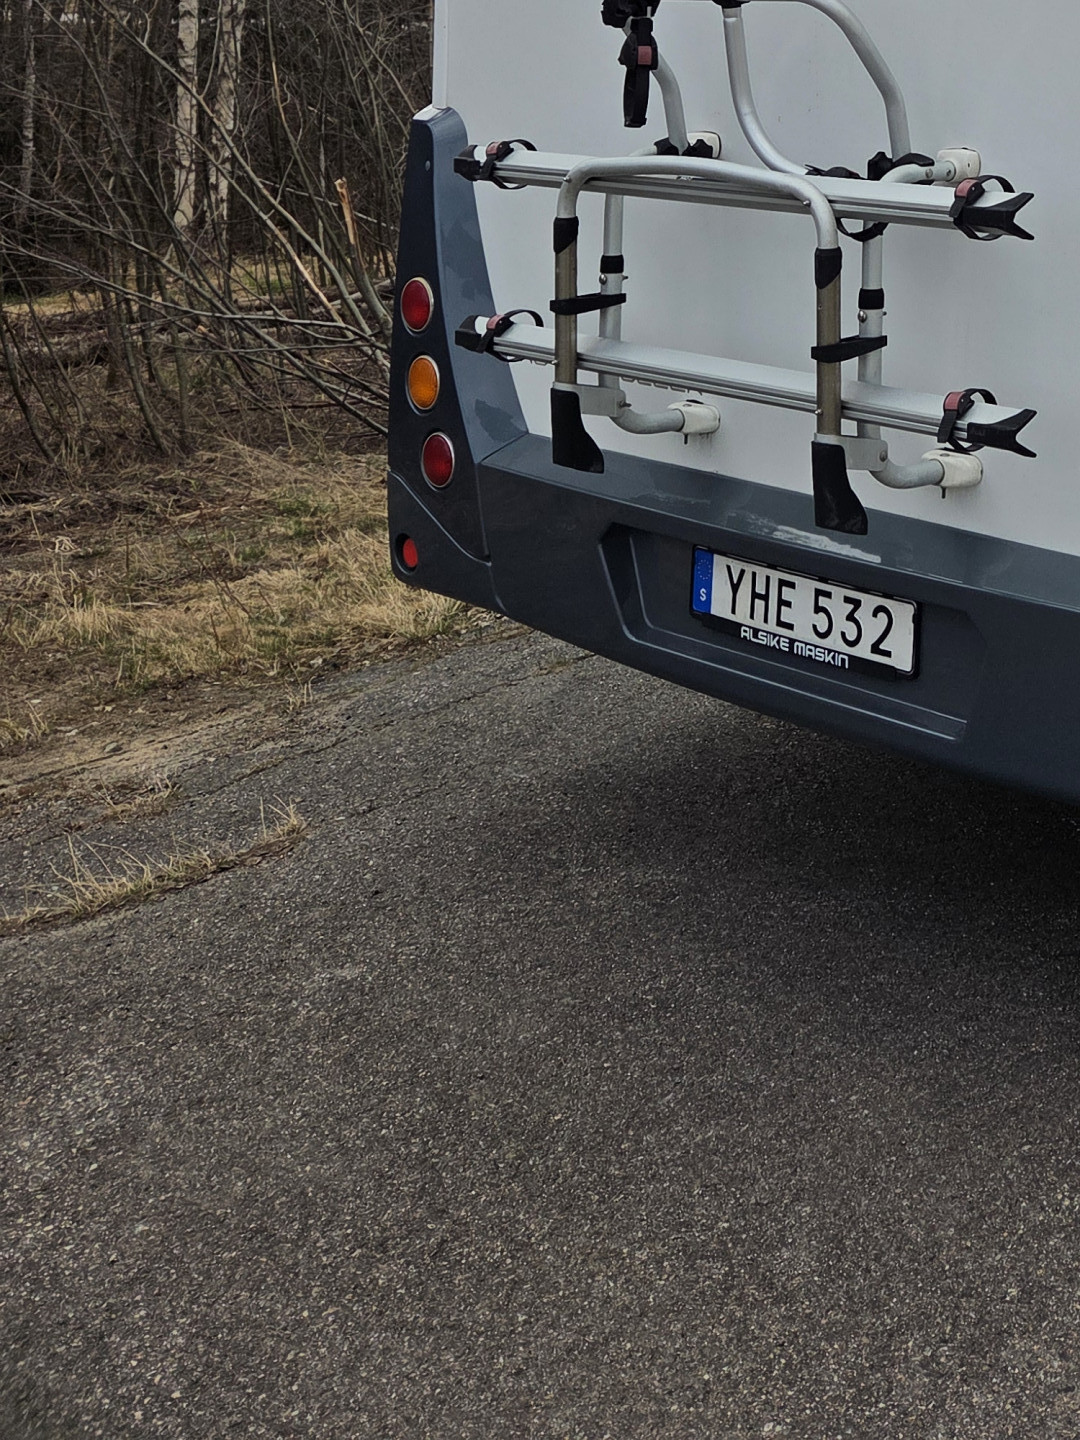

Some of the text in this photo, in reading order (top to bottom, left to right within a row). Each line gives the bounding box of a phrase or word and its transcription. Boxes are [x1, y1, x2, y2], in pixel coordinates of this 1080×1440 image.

[699, 588, 707, 601] S
[725, 564, 894, 658] YHE 532
[741, 626, 849, 669] ALSIKE MASKIN
